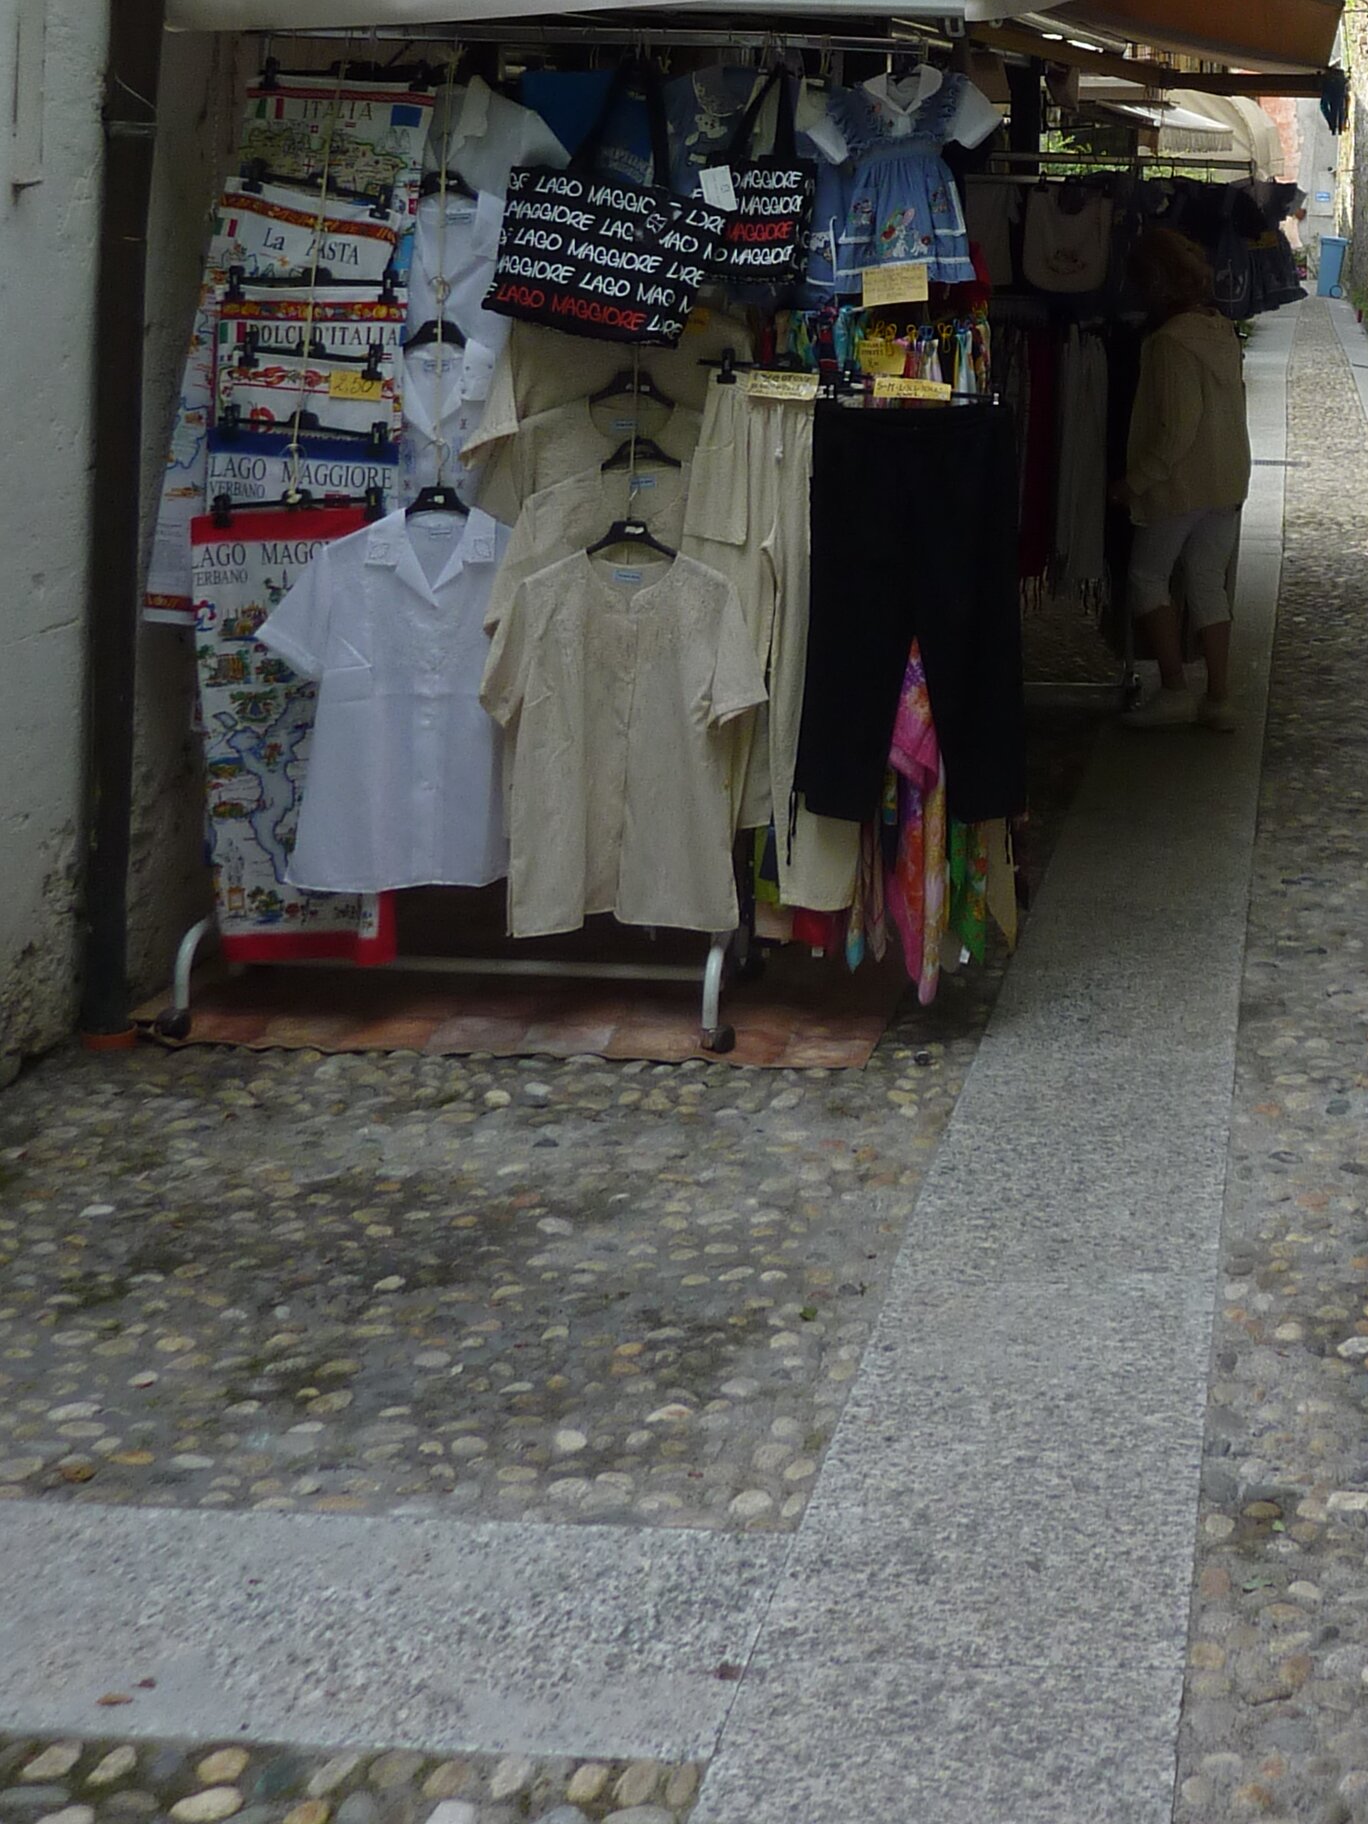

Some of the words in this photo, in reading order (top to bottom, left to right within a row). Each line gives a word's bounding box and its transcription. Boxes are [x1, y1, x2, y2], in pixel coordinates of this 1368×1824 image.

[302, 99, 373, 121] ITALIA
[535, 176, 582, 197] LAGO
[263, 227, 285, 251] La
[514, 227, 562, 251] LAGO
[567, 238, 663, 274] MAGGIORE
[579, 272, 630, 297] LAGO
[497, 285, 544, 309] LAGO
[552, 294, 646, 331] MAGGIORE
[209, 455, 267, 481] LAGO
[281, 460, 393, 490] MAGGIORE
[209, 480, 266, 498] VERBANO
[194, 568, 249, 587] ERBANO
